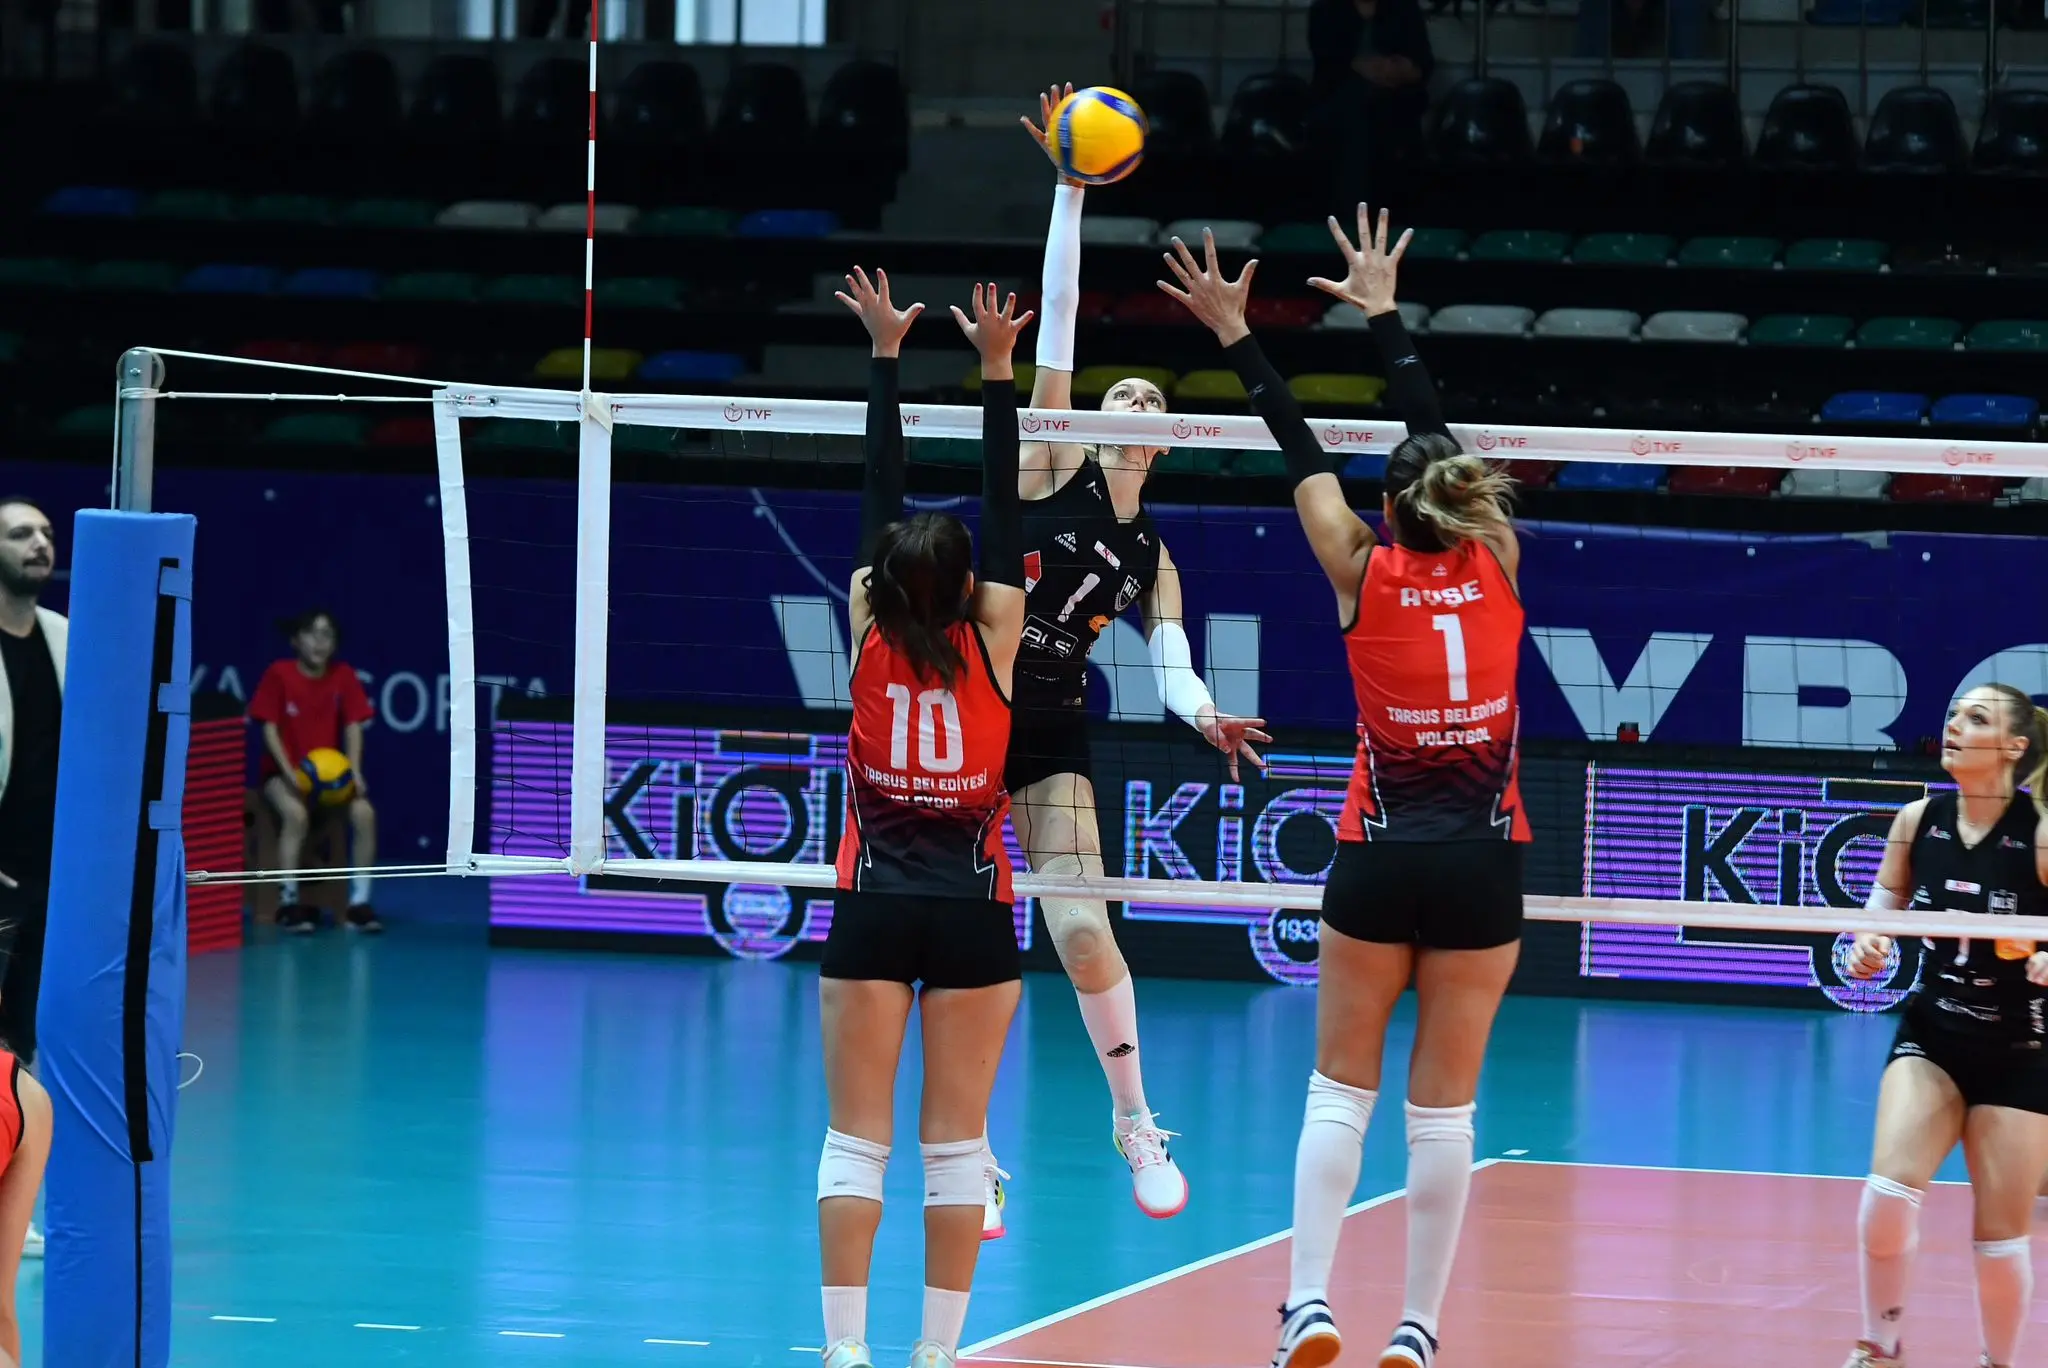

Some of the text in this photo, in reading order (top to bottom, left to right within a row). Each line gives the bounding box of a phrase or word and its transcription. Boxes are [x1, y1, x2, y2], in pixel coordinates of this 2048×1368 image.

[745, 408, 772, 420] TVF
[902, 415, 921, 426] VF
[1043, 420, 1070, 431] TVF
[1194, 426, 1222, 437] TVF
[1346, 432, 1374, 443] TVF
[1498, 437, 1527, 448] TVF
[1653, 442, 1682, 453] TVF
[1400, 579, 1484, 608] AYŞE
[1432, 613, 1469, 702] 1
[1385, 706, 1440, 725] TARSUS
[886, 682, 964, 773] 10
[1415, 726, 1492, 746] VOLEYBOL
[863, 763, 909, 790] TARSUS
